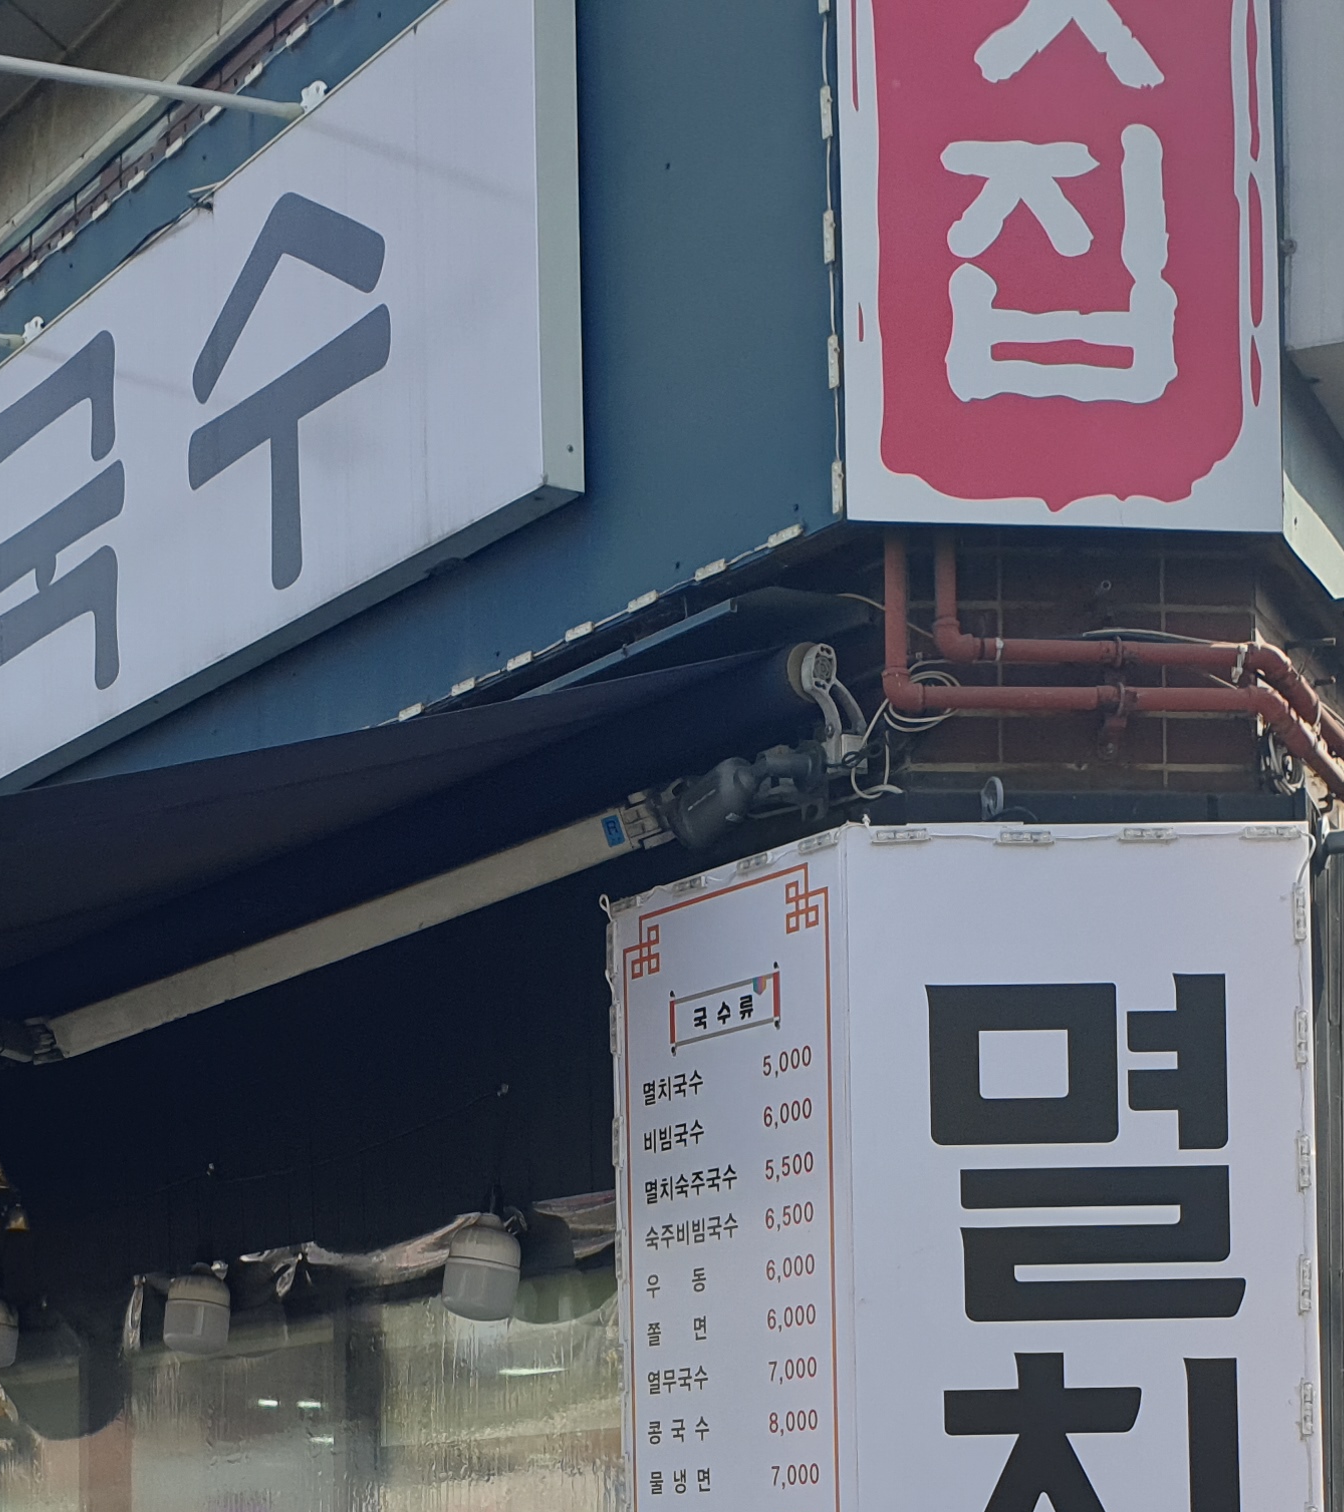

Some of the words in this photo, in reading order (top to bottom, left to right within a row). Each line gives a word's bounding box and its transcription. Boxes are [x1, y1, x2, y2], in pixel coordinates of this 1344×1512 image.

[642, 1069, 704, 1106] 멸치국수
[762, 1045, 812, 1078] 5,000
[643, 1119, 705, 1154] 비빔국수
[763, 1097, 812, 1130] 6,000
[644, 1164, 738, 1204] 멸치숙주국수
[764, 1151, 815, 1182] 5,500
[644, 1213, 739, 1250] 숙주비빔국수
[764, 1202, 815, 1232] 6,500
[765, 1254, 815, 1283] 6,000
[767, 1303, 816, 1332] 6,000
[648, 1366, 708, 1395] 열무국수
[768, 1356, 817, 1384] 7,000
[769, 1409, 818, 1436] 8,000
[771, 1463, 819, 1490] 7,000
